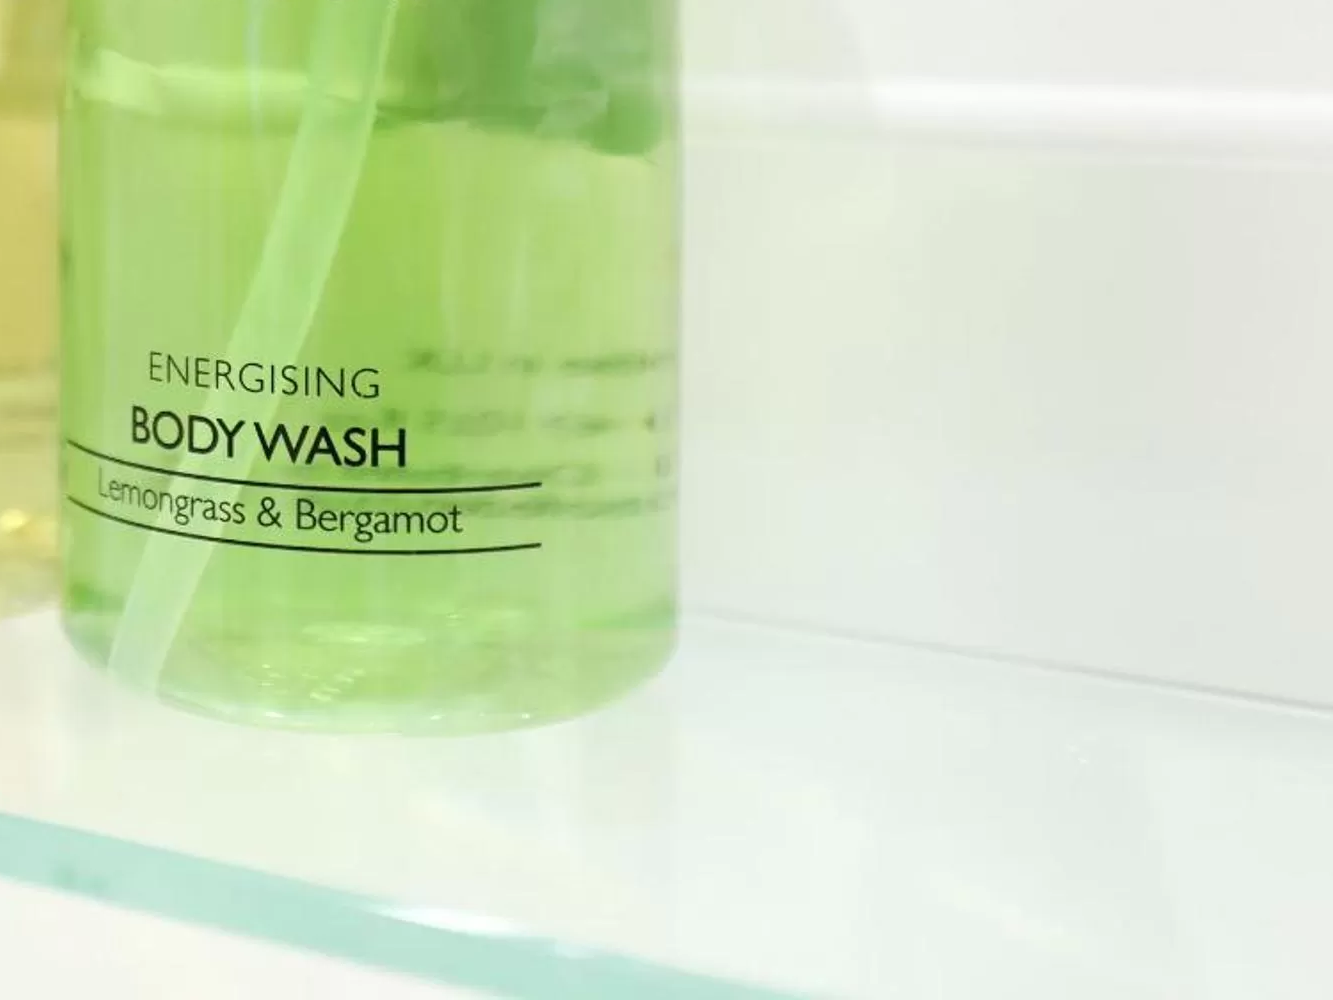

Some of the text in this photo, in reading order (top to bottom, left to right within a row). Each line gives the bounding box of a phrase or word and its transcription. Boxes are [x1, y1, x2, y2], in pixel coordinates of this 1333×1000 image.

[148, 350, 382, 400] ENERGISING
[130, 404, 245, 459] BODY
[254, 420, 408, 469] WASH
[97, 474, 246, 527] Lemongrass
[256, 495, 284, 530] &
[295, 497, 465, 544] Bergamot
